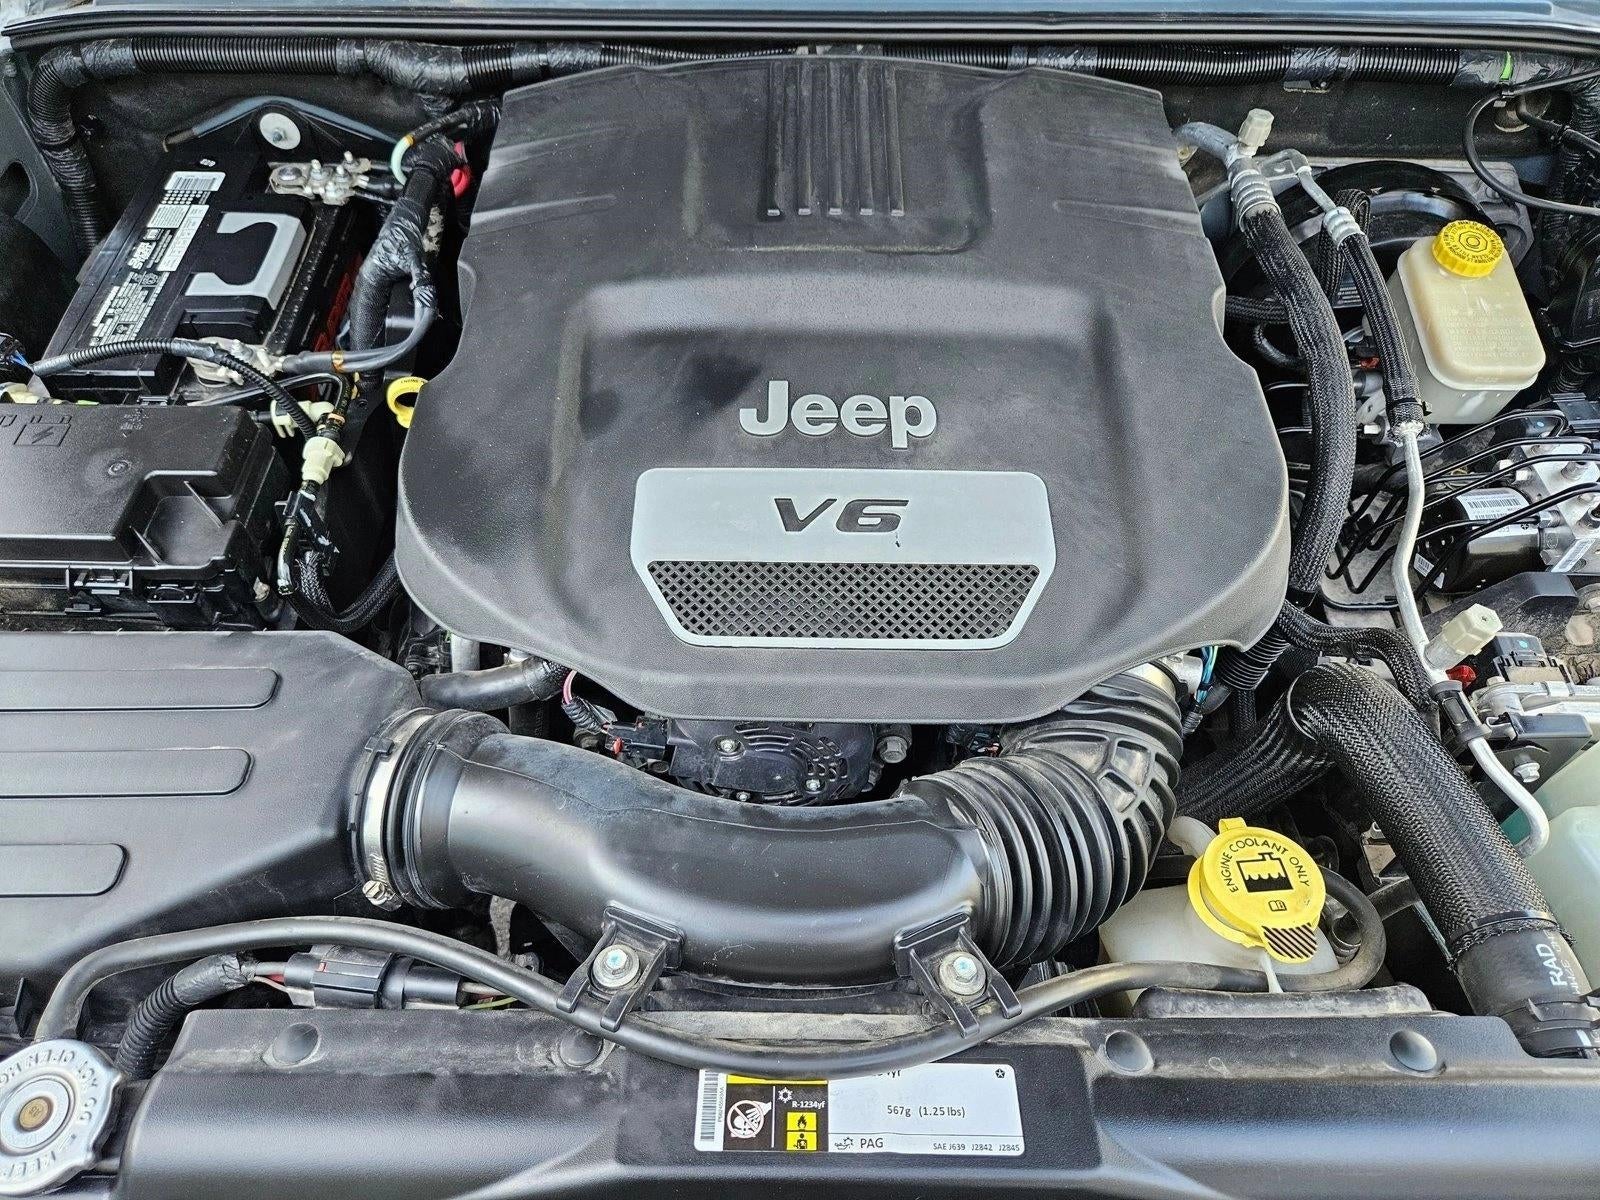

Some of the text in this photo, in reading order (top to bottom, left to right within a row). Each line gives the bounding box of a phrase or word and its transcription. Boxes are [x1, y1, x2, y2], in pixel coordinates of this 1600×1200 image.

[739, 379, 938, 450] Jeep
[773, 498, 910, 533] V6
[1221, 838, 1311, 893] ENGINE COOLANT ONLY
[1535, 943, 1568, 987] RAD
[791, 1100, 826, 1110] R-1234yf
[887, 1104, 966, 1118] 567g (1.25 lbs)
[860, 1137, 884, 1149] PAG
[933, 1142, 947, 1151] SAE
[949, 1143, 966, 1151] J639
